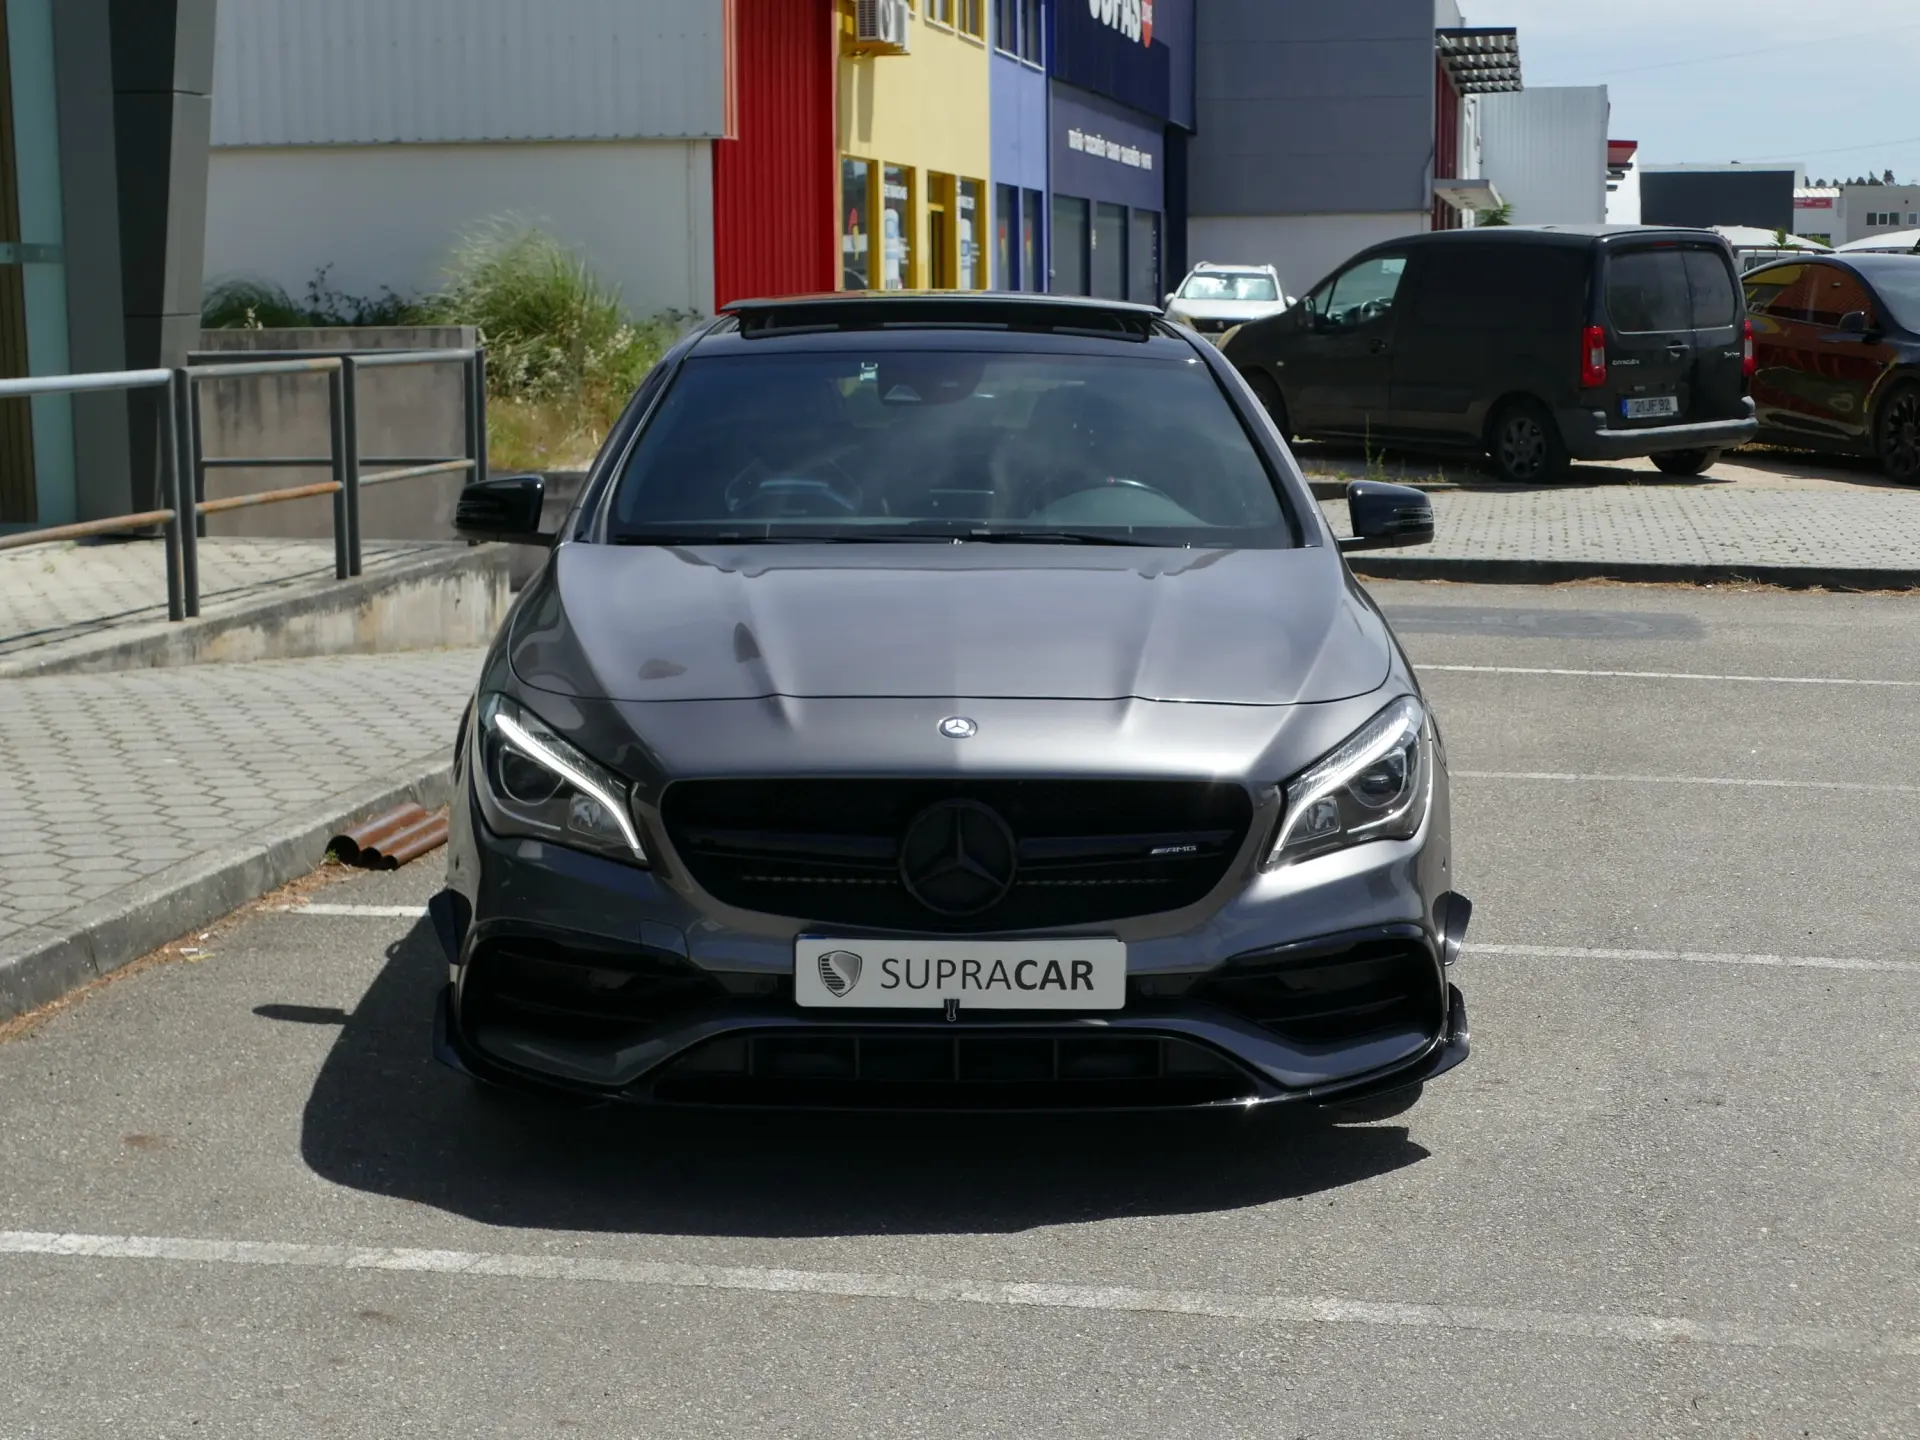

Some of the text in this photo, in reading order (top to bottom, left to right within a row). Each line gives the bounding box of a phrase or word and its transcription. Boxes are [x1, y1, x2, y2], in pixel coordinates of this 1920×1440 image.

[1635, 400, 1645, 413] 21
[1659, 398, 1672, 411] 92
[1166, 845, 1197, 853] AMG
[880, 958, 1095, 991] SUPRACAR
